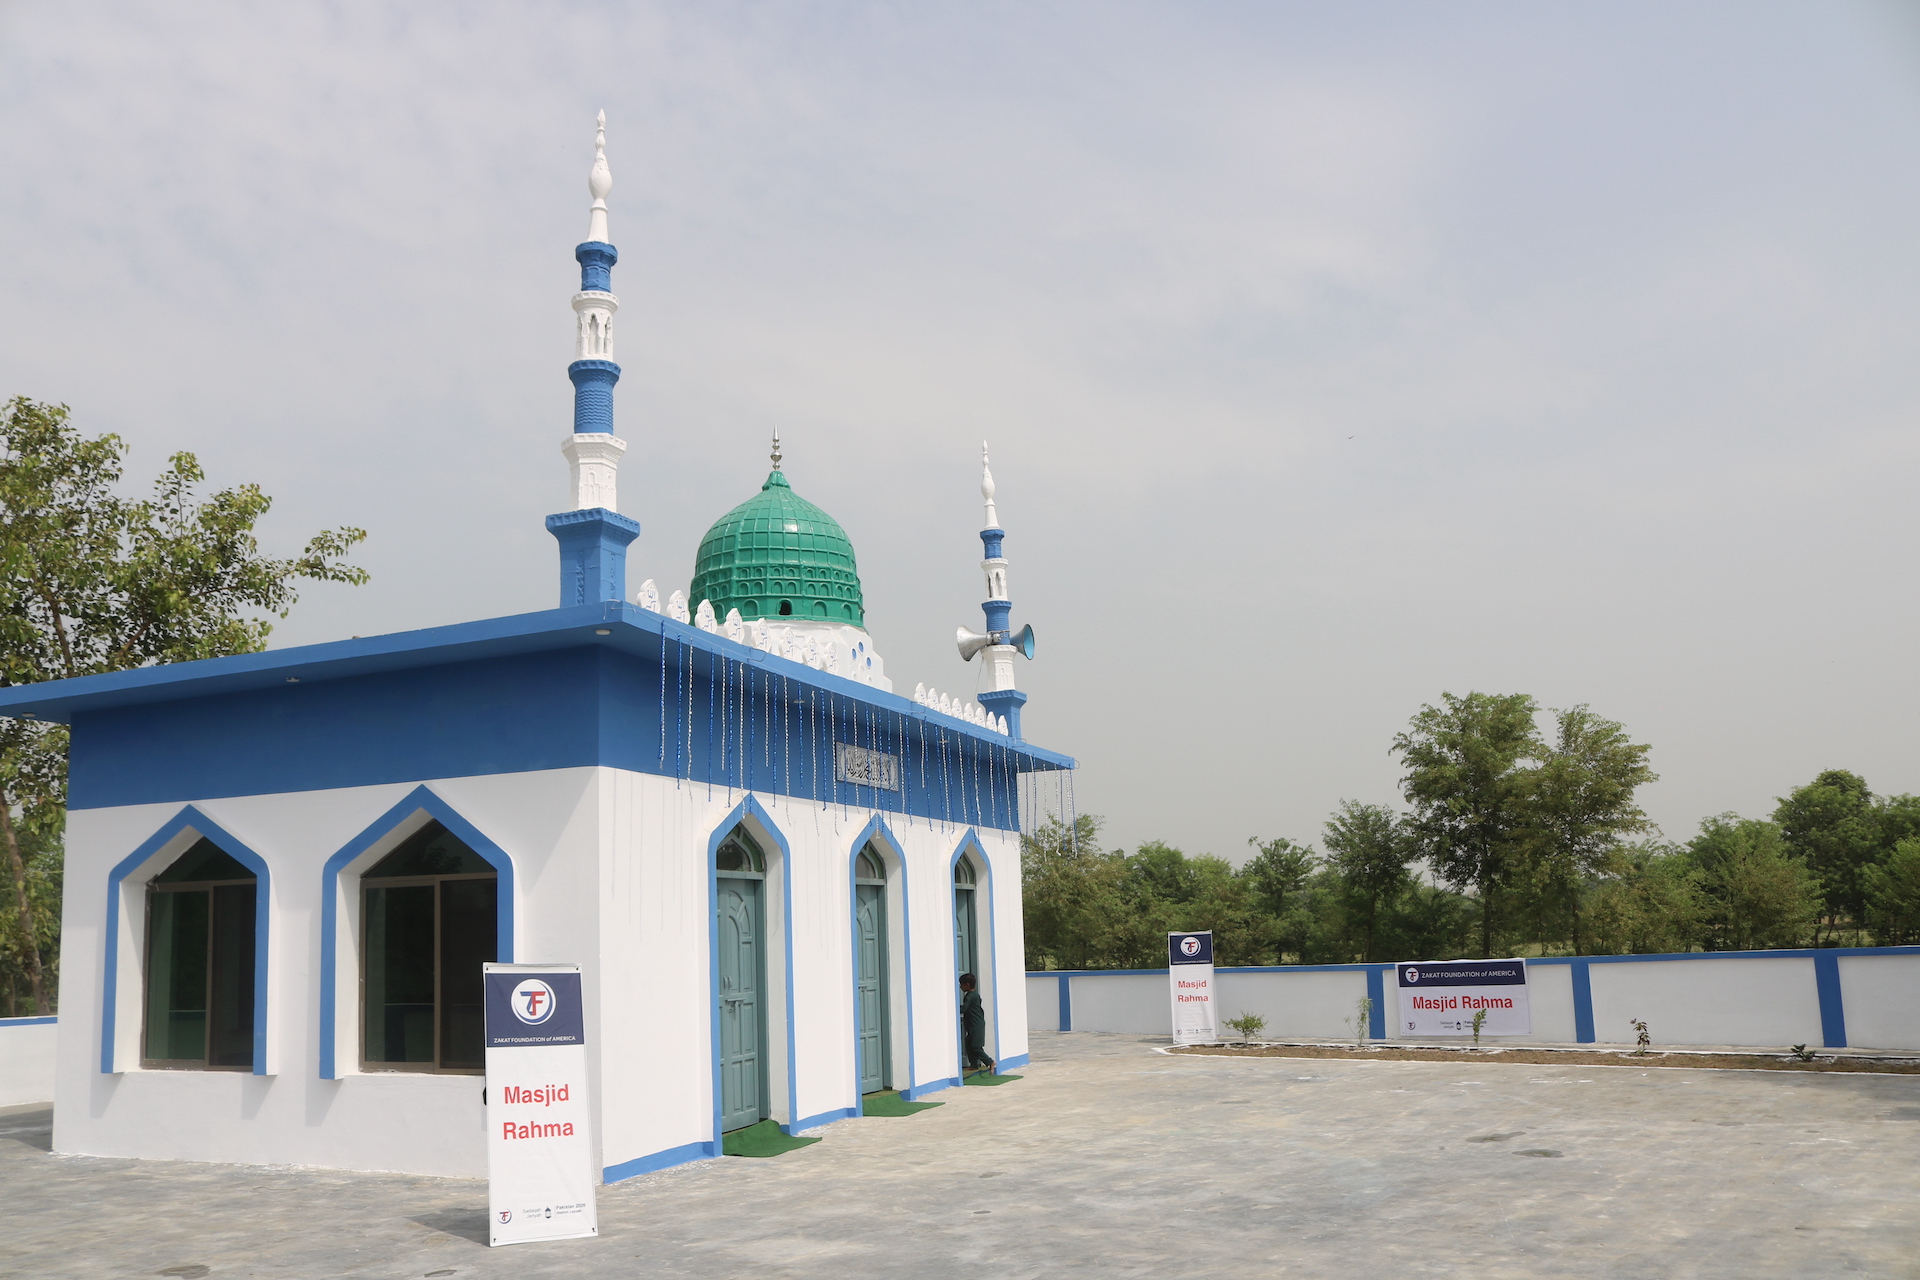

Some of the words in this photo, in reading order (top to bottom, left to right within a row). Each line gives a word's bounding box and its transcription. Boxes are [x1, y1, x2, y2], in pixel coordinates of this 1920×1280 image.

[1178, 980, 1207, 989] Masjid
[1177, 994, 1209, 1003] Rahma
[1413, 996, 1457, 1012] Masjid
[1461, 995, 1513, 1009] Rahma
[504, 1083, 569, 1107] Masjid
[503, 1120, 574, 1140] Rahma
